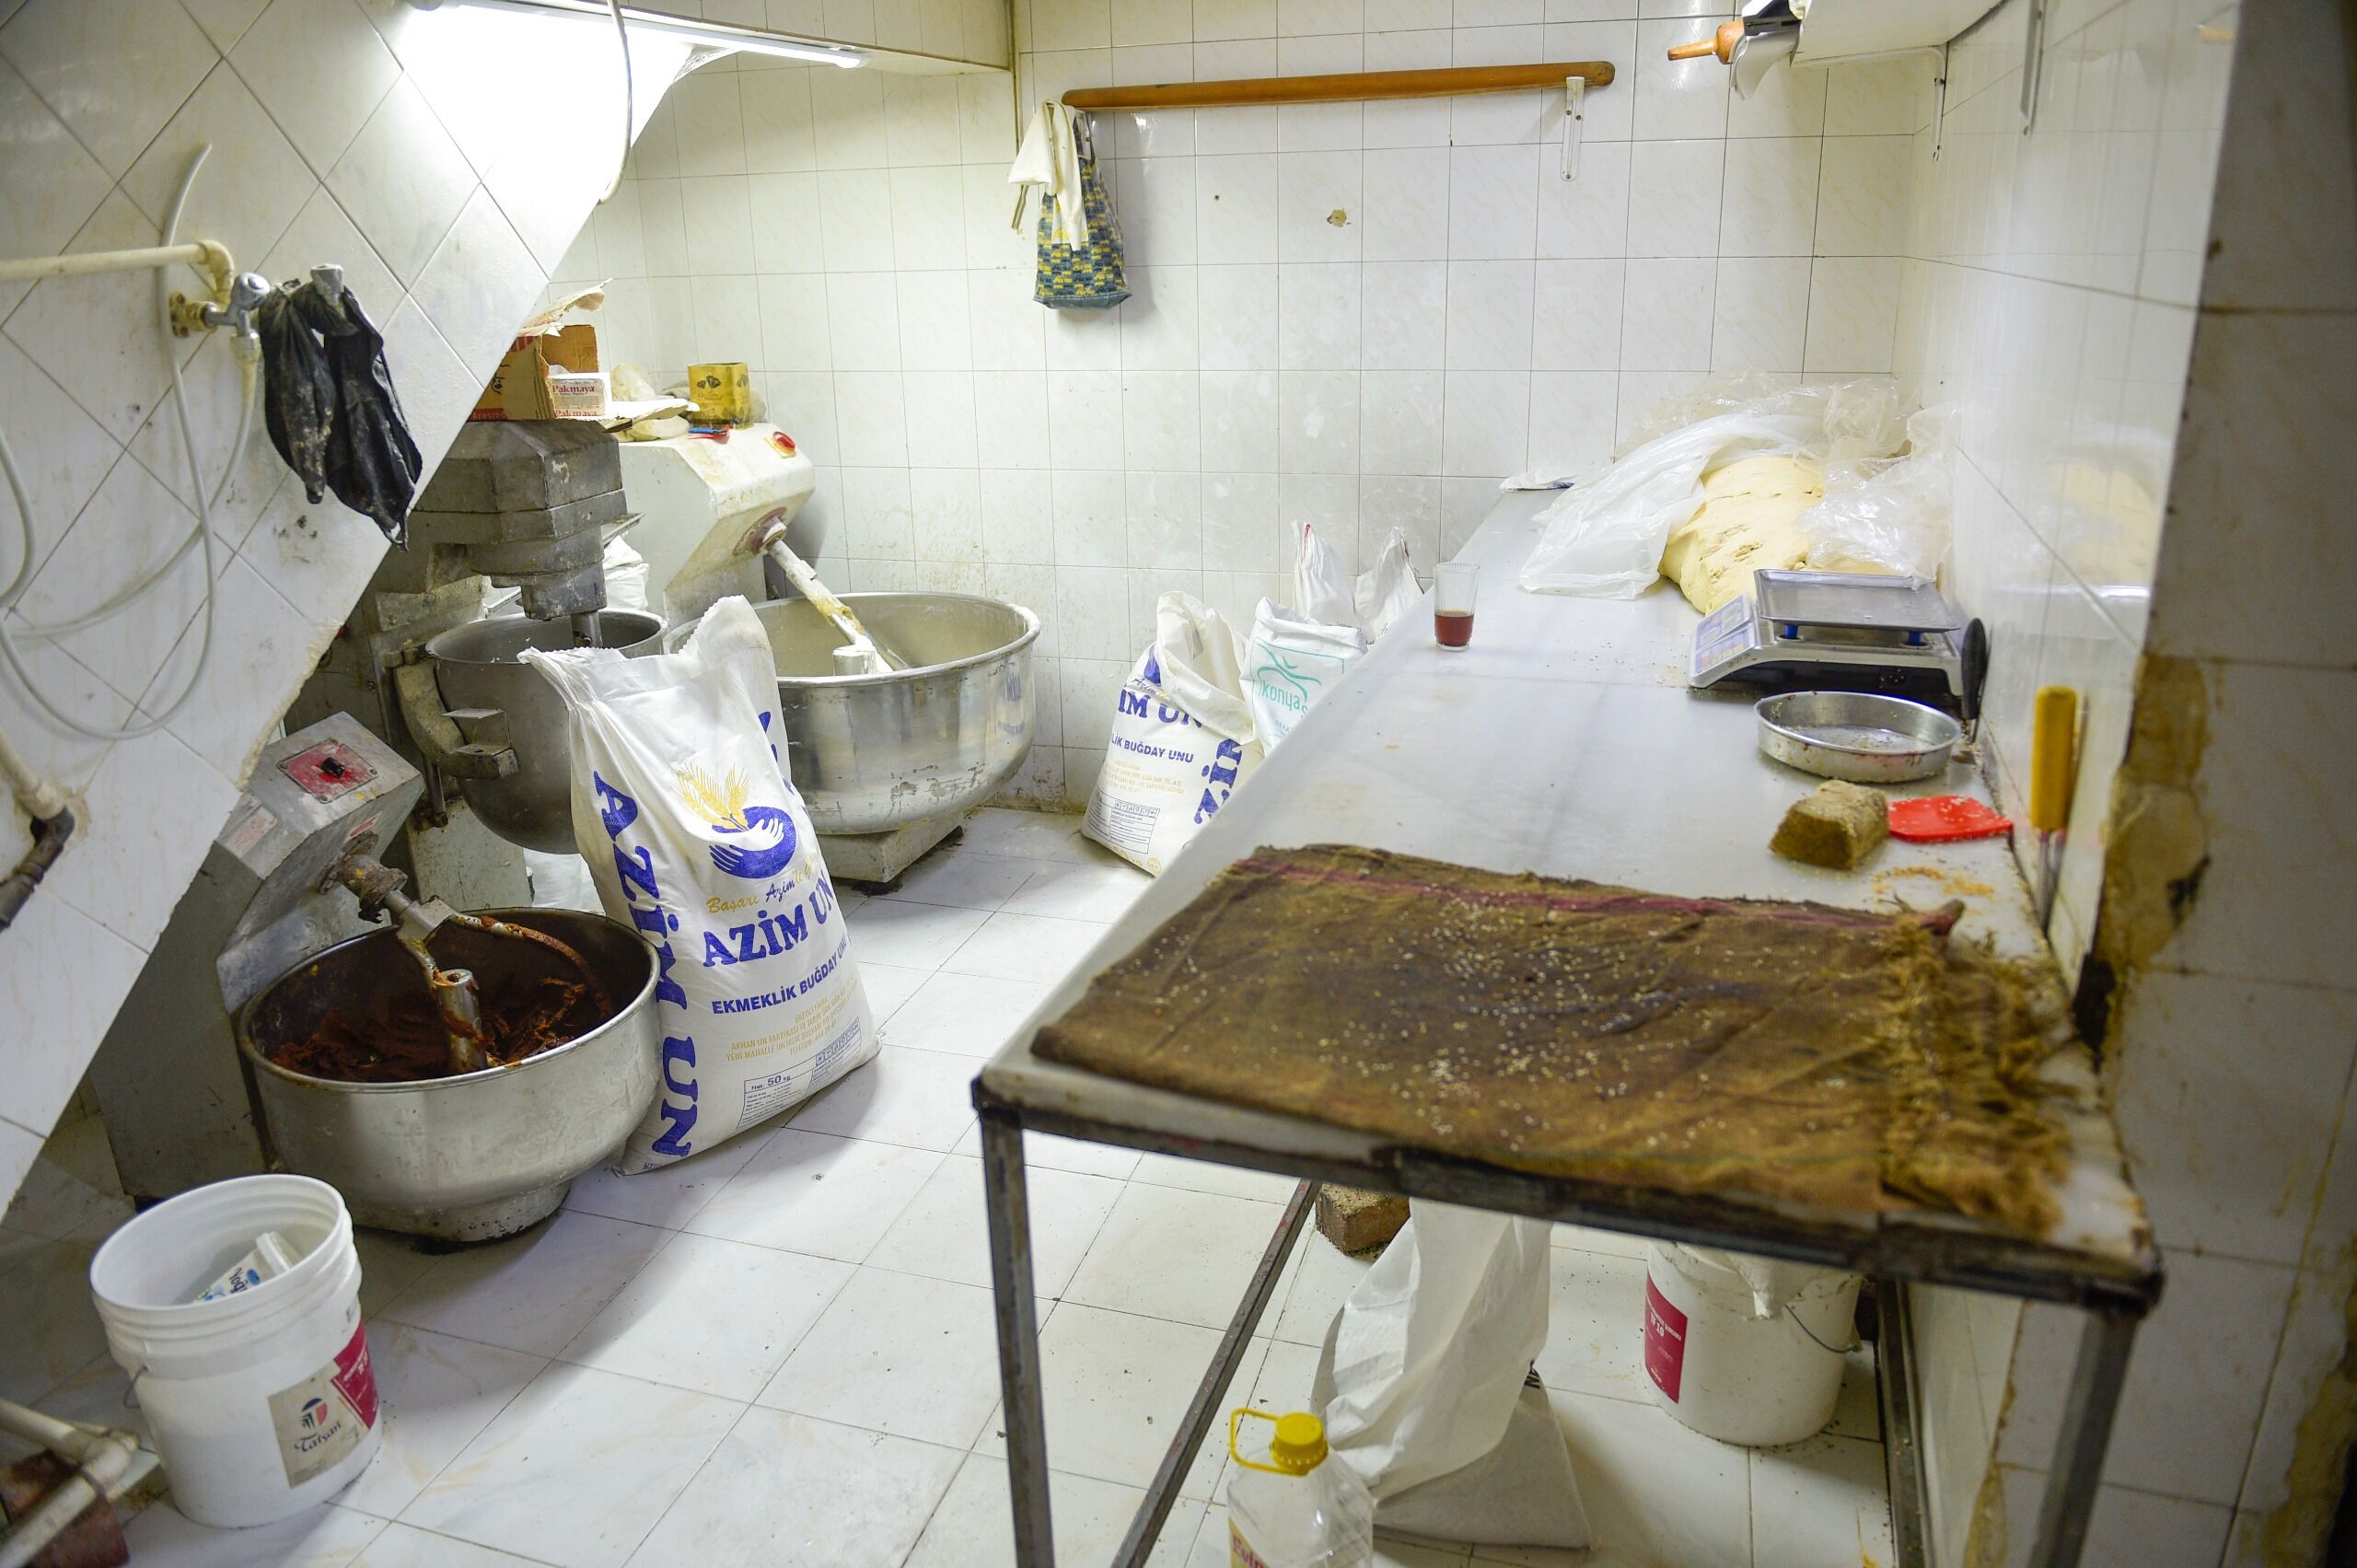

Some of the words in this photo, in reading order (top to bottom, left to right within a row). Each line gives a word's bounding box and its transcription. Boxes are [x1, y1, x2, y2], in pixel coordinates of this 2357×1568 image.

[552, 384, 596, 395] Pakmaya
[1124, 739, 1166, 758] BUĞDAY
[1168, 749, 1194, 763] UNU
[702, 903, 809, 968] AZİM
[593, 771, 688, 1010] AZİM
[652, 1035, 698, 1157] UN
[711, 985, 797, 1015] EKMEKLİK
[799, 952, 838, 995] BUĞDAY
[767, 1074, 782, 1086] 50
